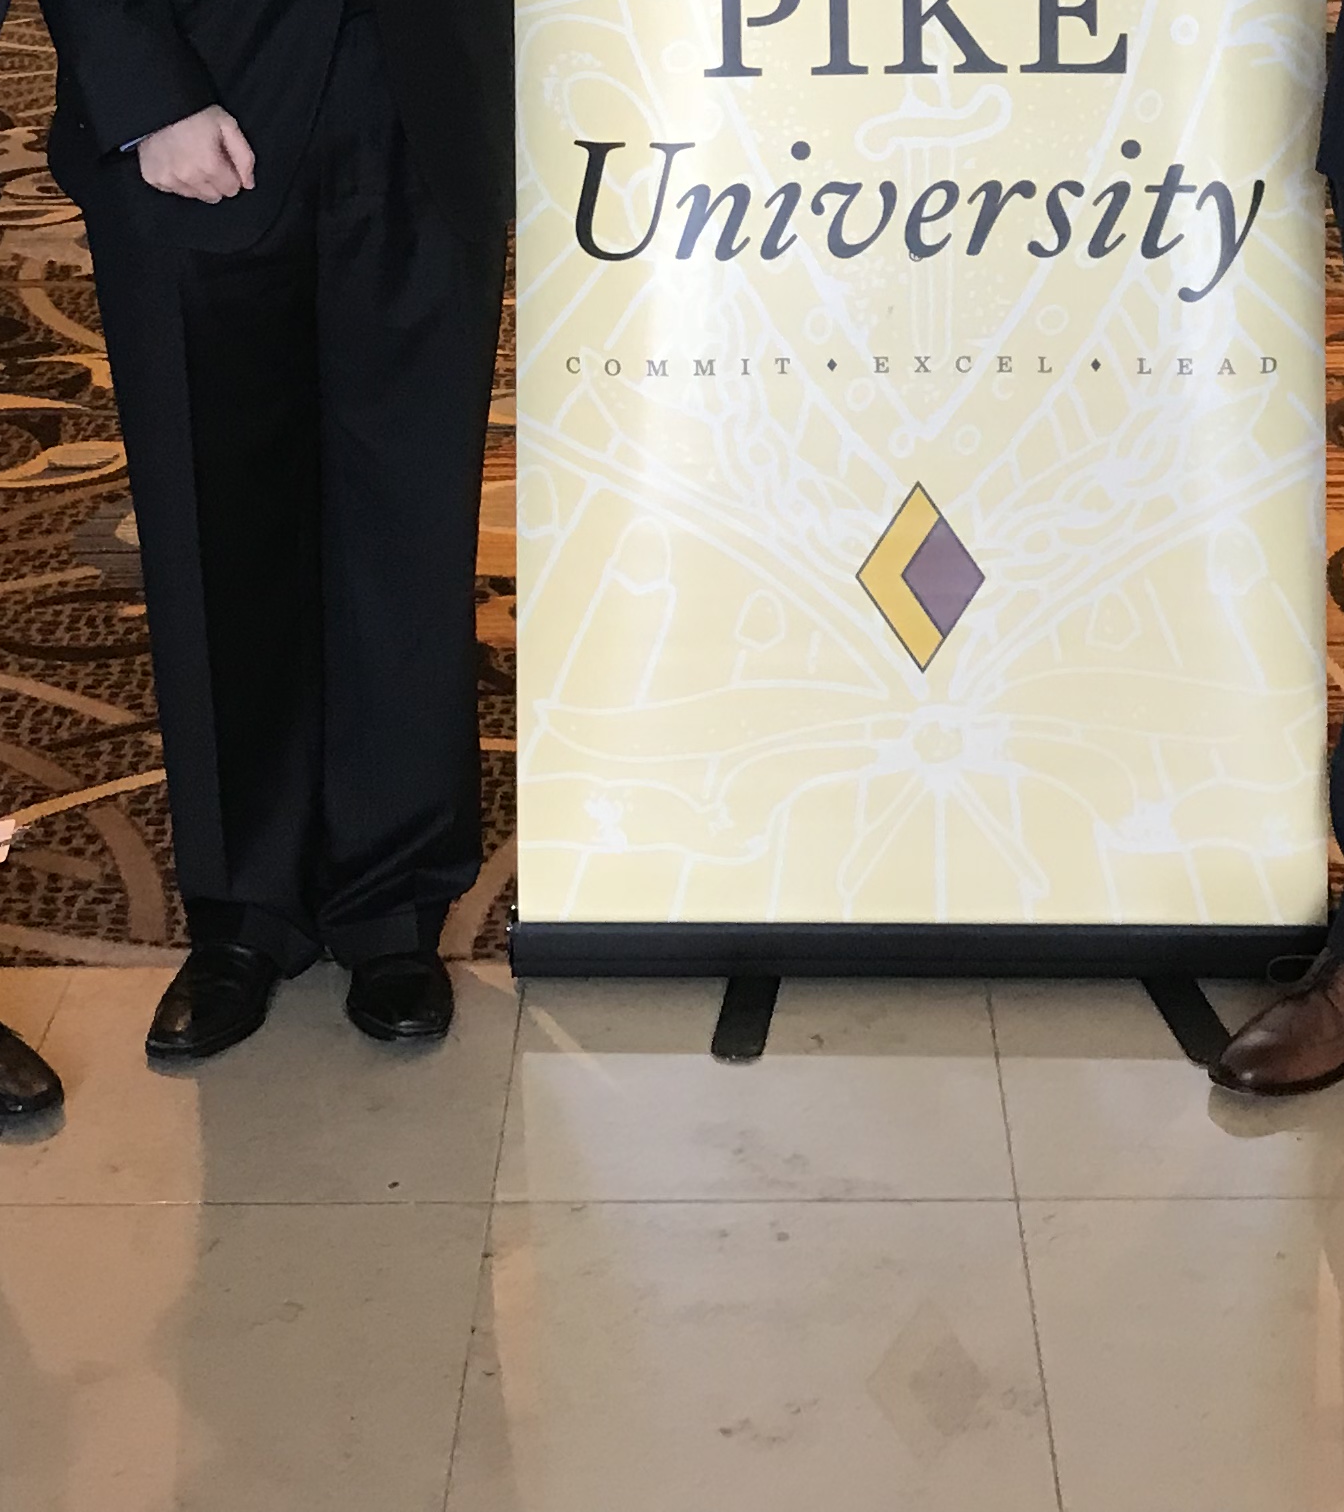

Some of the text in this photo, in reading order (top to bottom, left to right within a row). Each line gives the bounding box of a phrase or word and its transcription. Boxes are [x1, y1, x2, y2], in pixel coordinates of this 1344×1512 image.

[572, 138, 1267, 304] University
[565, 354, 1279, 378] COMMIT EXCEL LEAD
